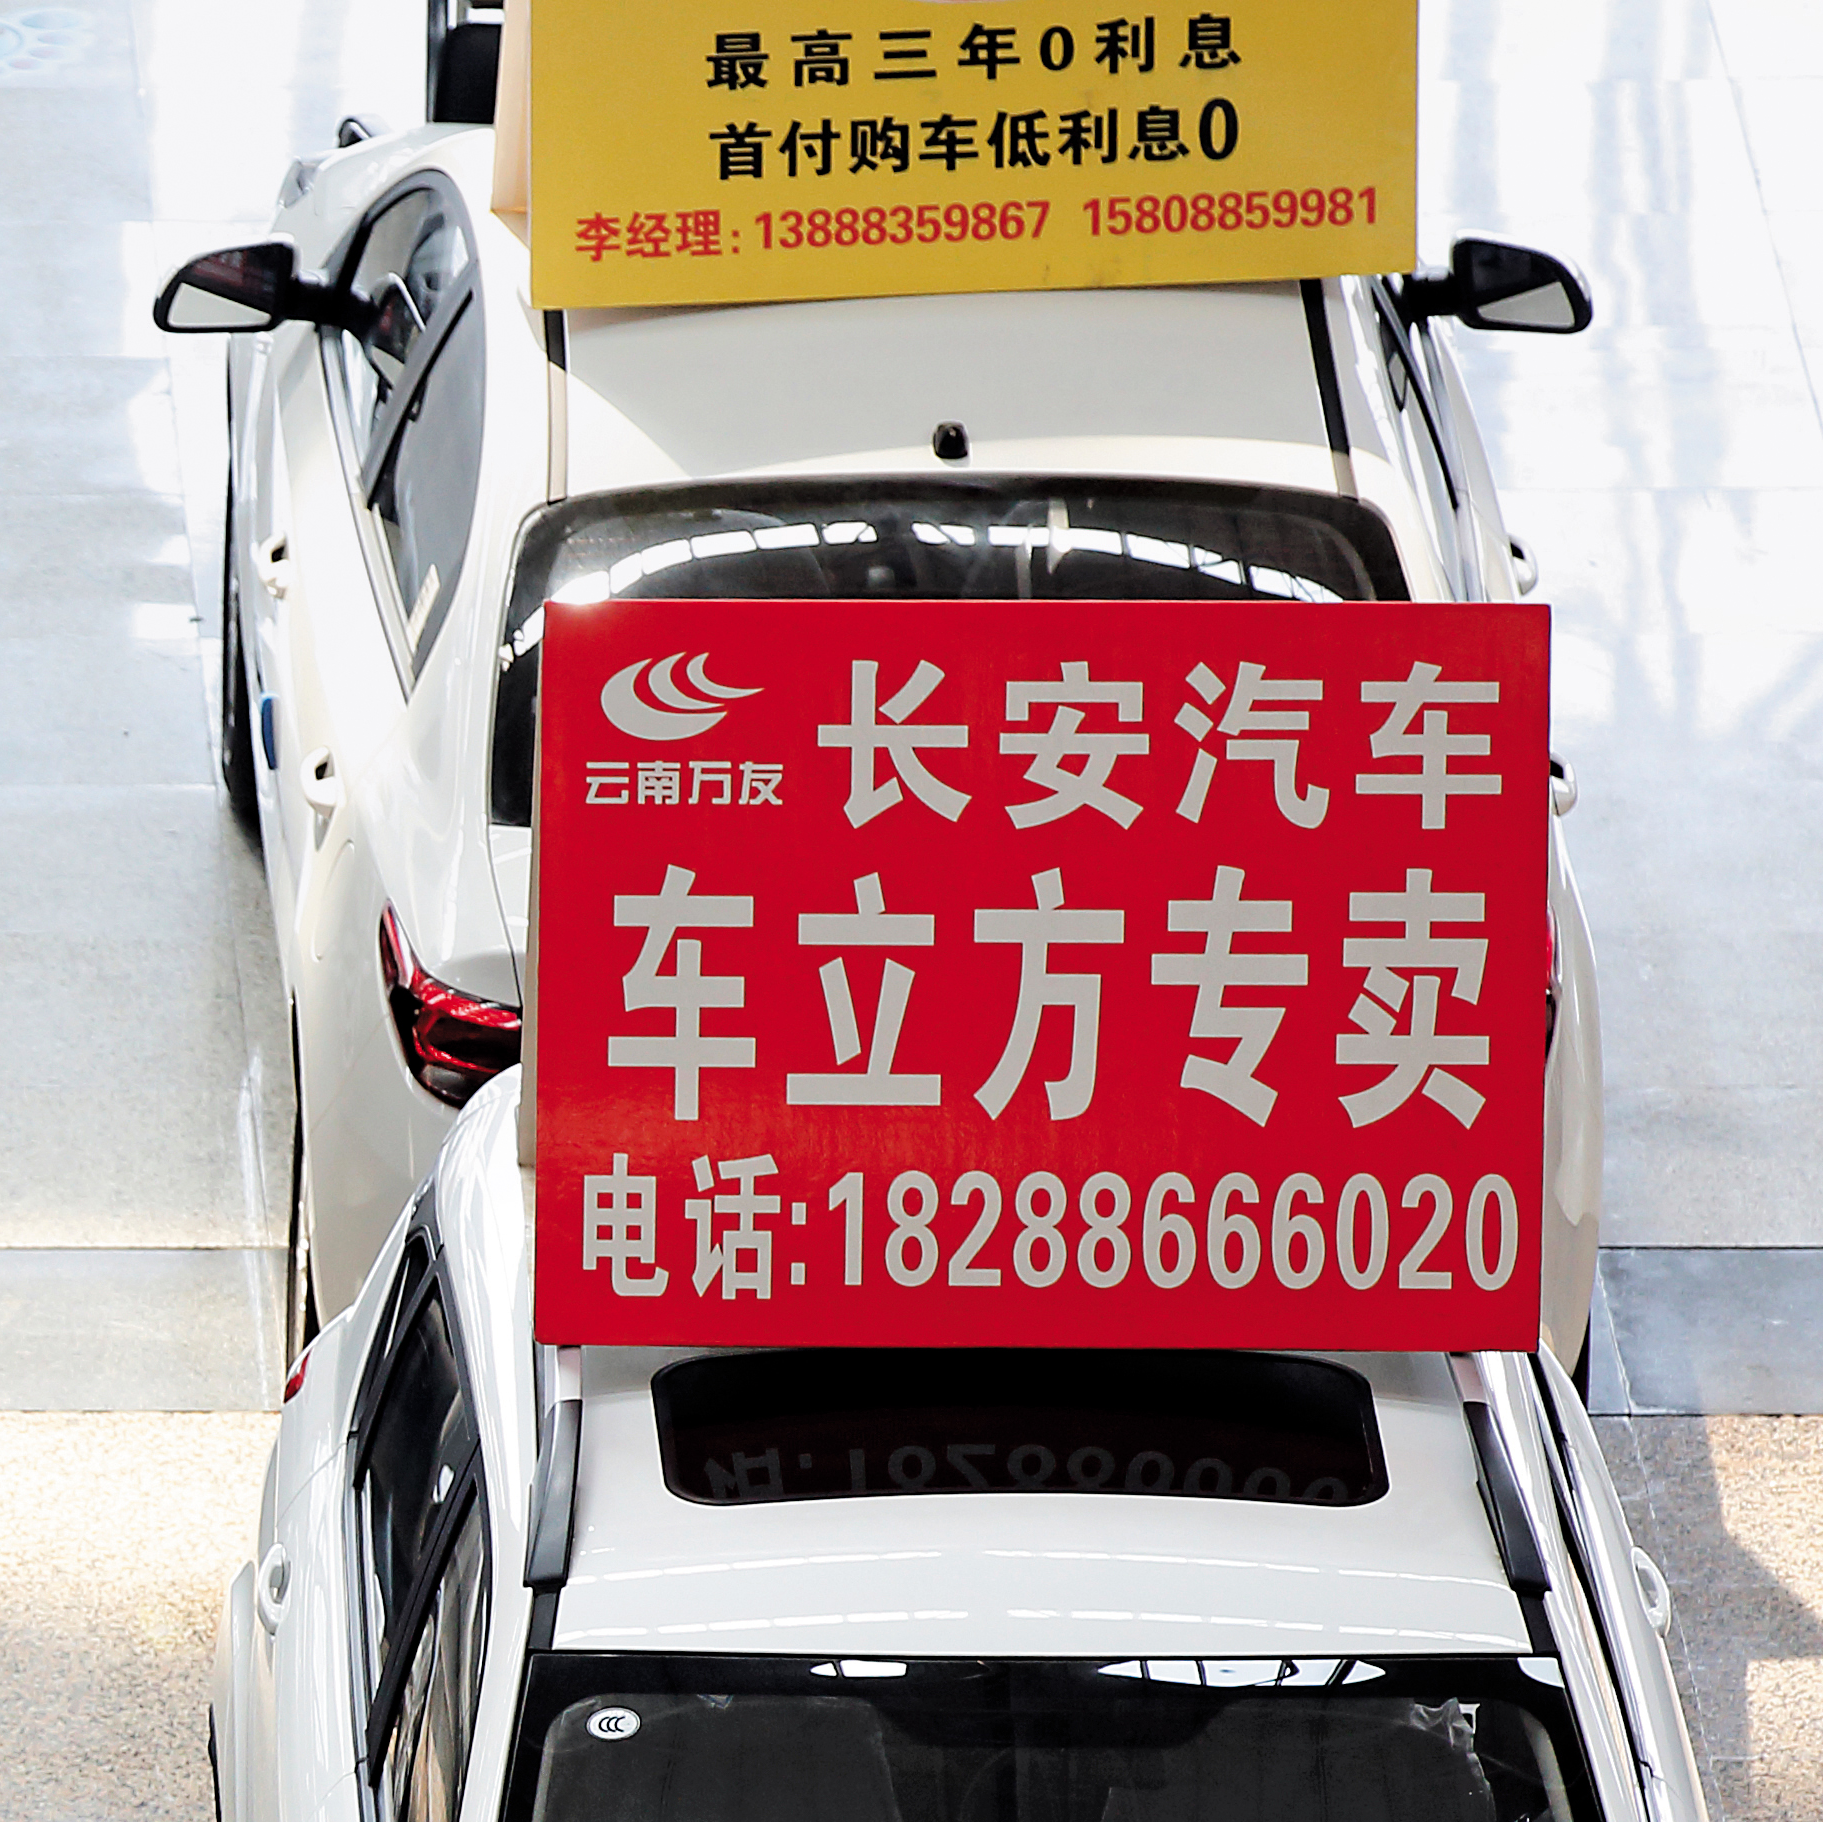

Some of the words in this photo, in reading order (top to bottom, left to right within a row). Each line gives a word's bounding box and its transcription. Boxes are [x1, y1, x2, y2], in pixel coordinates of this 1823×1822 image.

[707, 14, 1240, 90] 最高三年0利息
[710, 99, 1238, 180] 首付购车低利息0
[756, 201, 1049, 248] 13888359867
[1082, 187, 1377, 236] 15808859981
[586, 761, 783, 805] 云南万友
[818, 660, 1502, 829] 长安汽车
[608, 865, 1489, 1128] 车立方专卖
